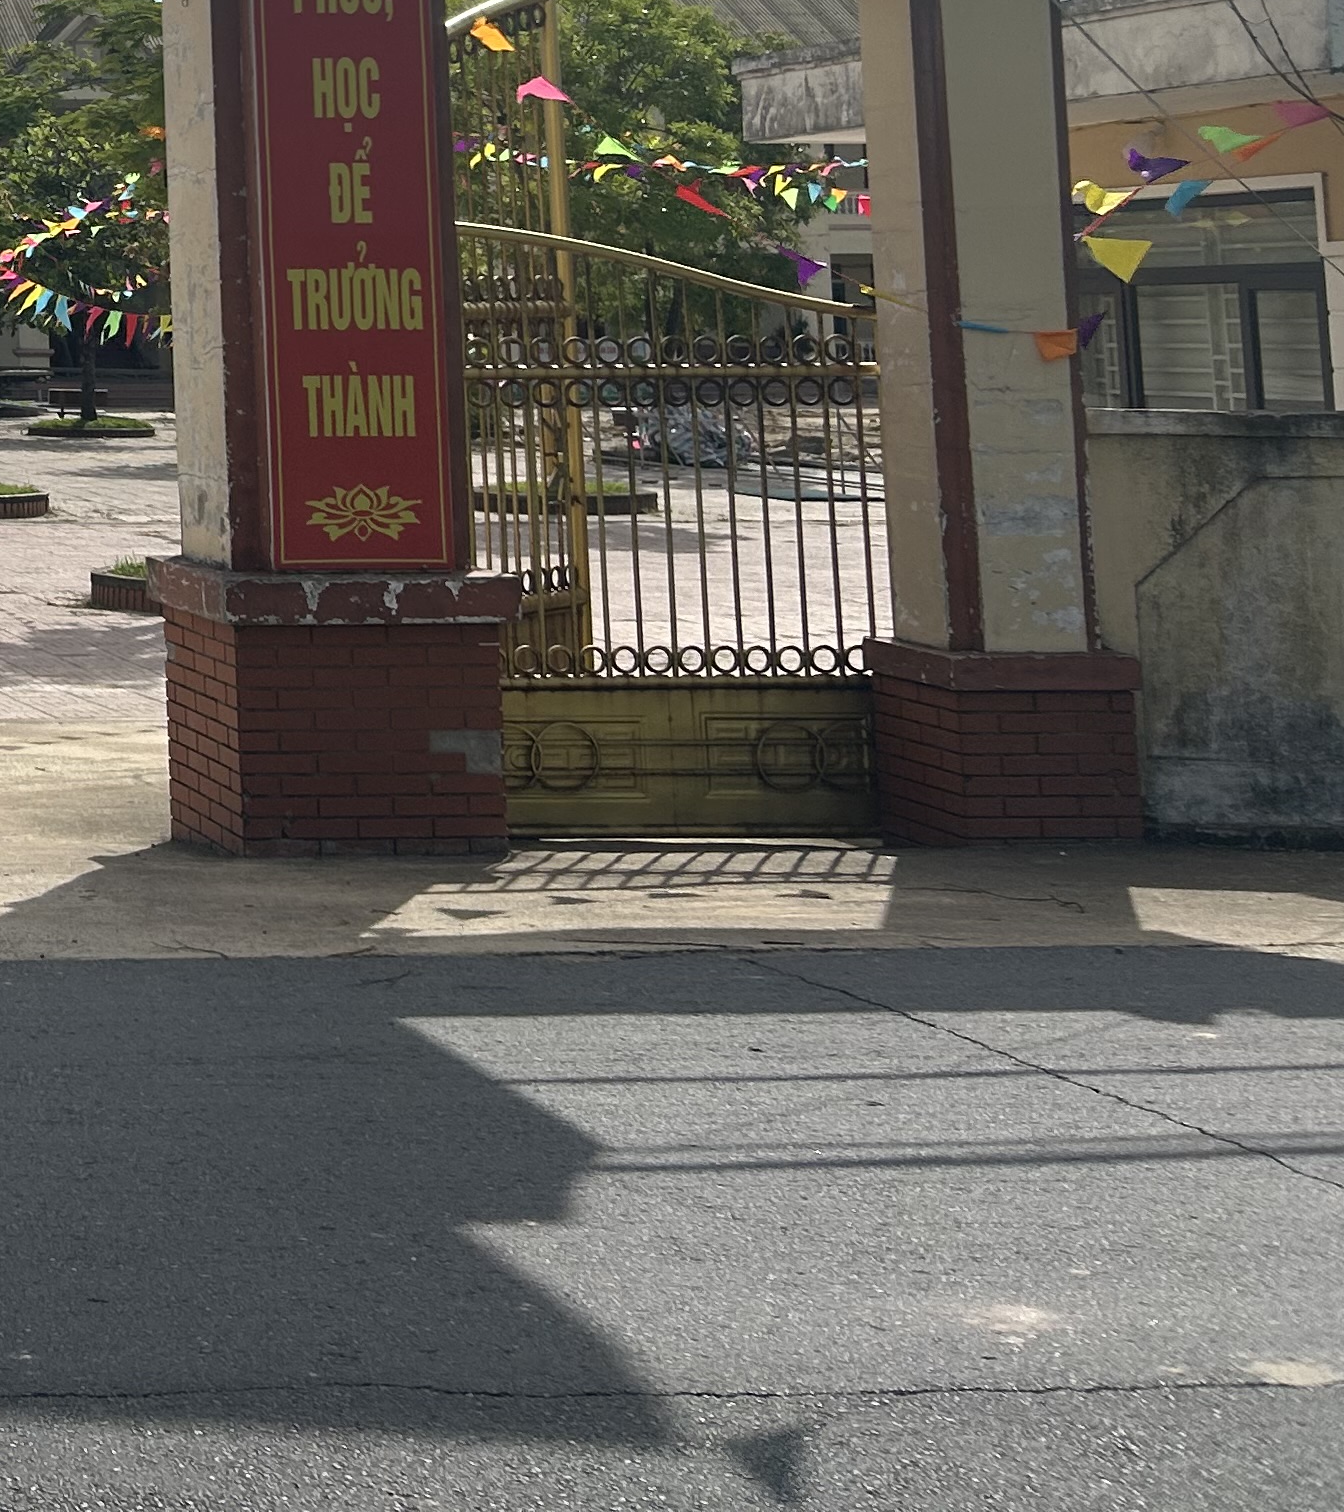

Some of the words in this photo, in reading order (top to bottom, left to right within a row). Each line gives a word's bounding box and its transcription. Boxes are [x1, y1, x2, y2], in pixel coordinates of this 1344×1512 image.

[312, 56, 381, 133] HỌC
[328, 137, 374, 225] ĐỂ
[287, 240, 424, 332] TRƯỞNG
[303, 361, 417, 438] THÀNH
